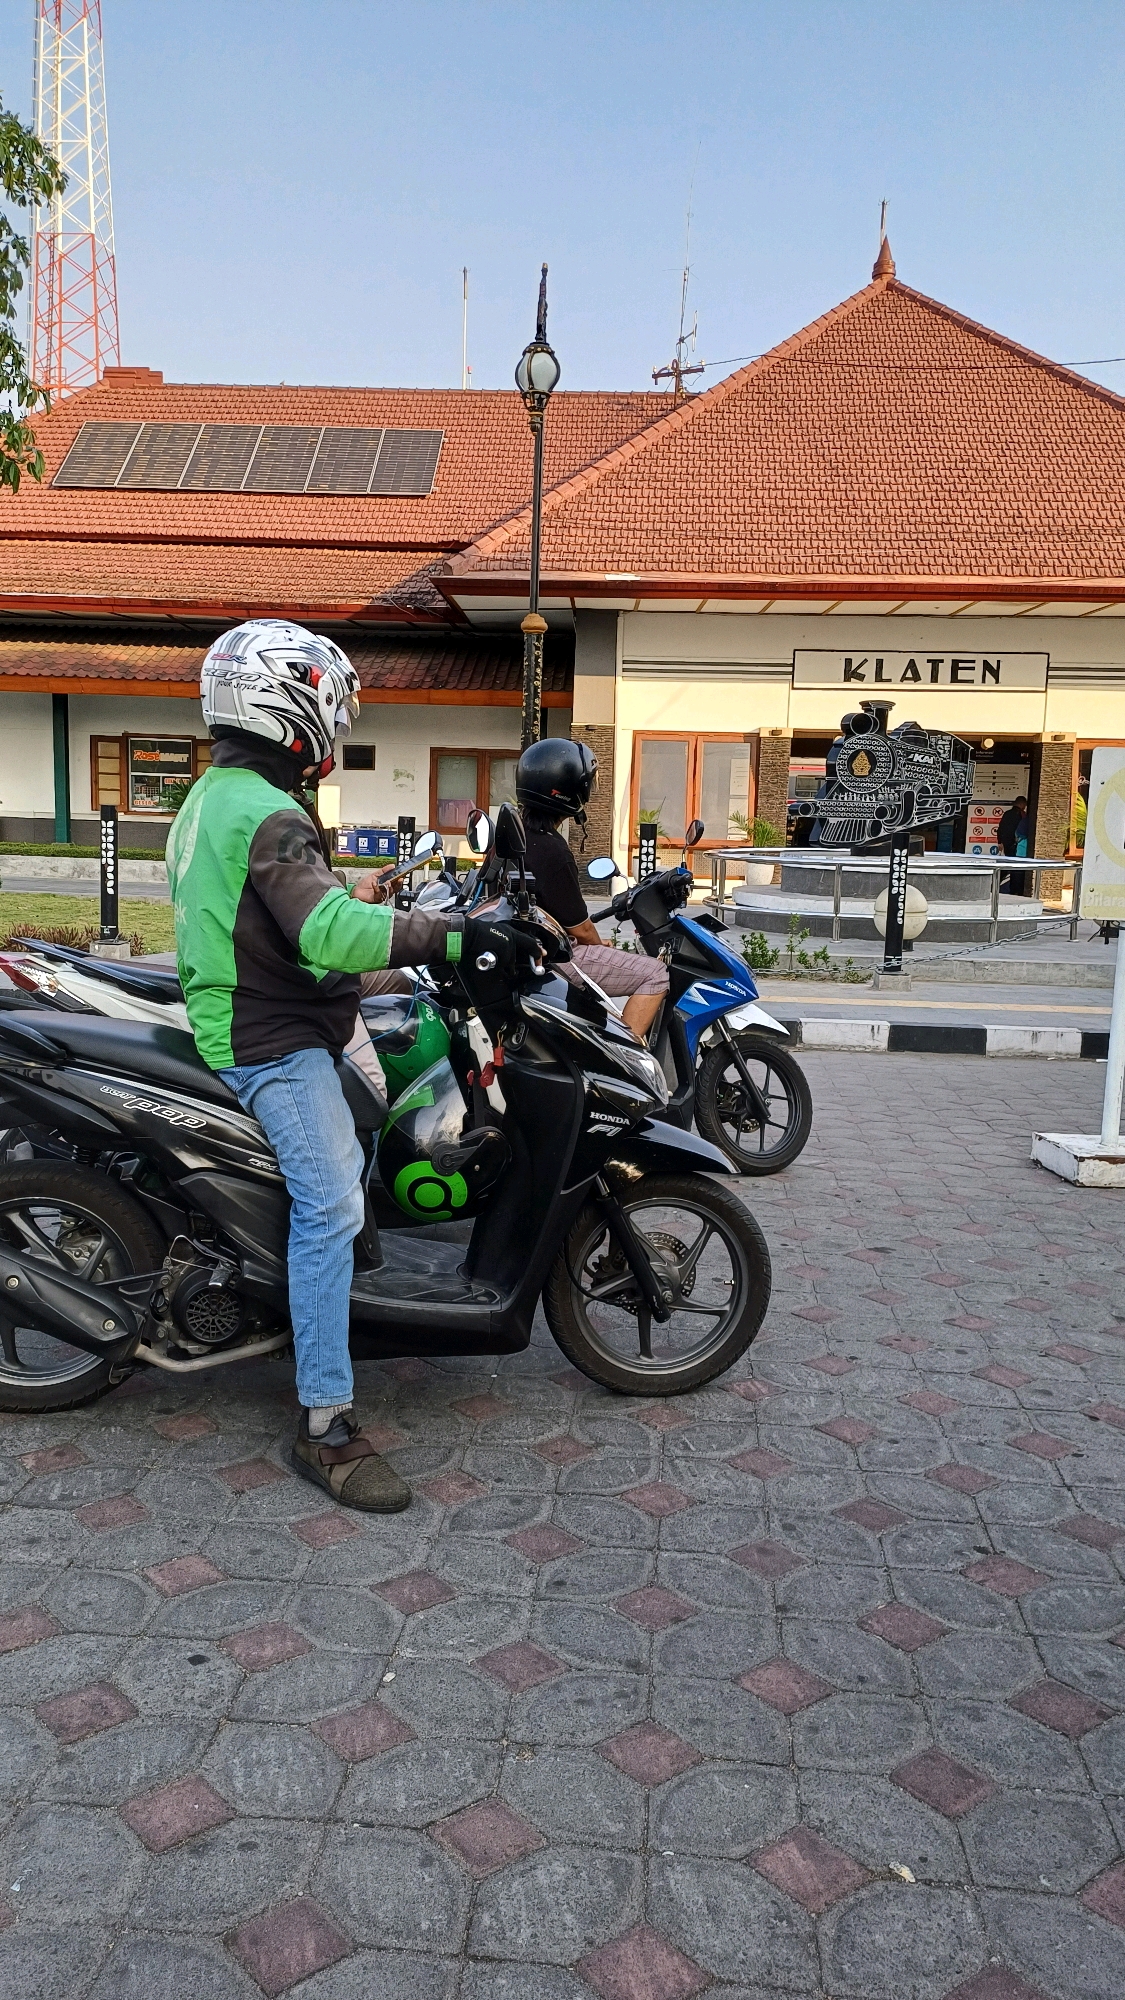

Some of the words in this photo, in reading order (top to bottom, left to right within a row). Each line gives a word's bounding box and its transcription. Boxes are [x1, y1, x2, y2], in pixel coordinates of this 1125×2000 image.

[203, 668, 261, 682] REVO
[843, 657, 1001, 684] KLATEN
[912, 753, 933, 765] KAI
[724, 980, 747, 997] HONDA
[589, 1111, 631, 1126] HONDA
